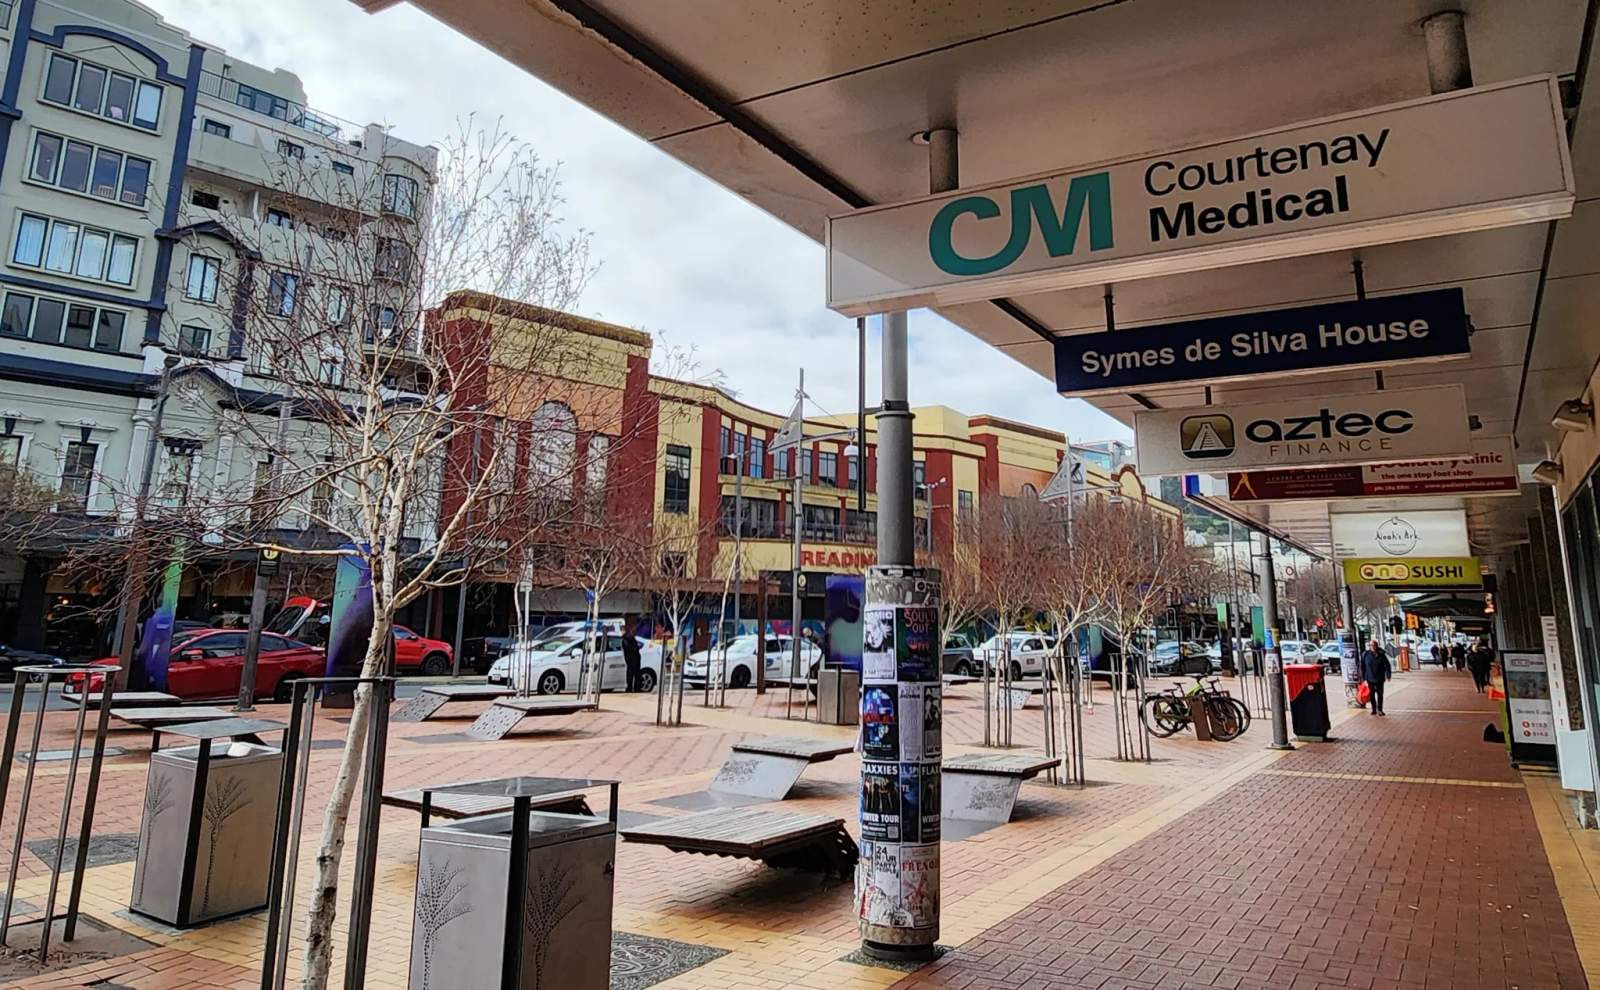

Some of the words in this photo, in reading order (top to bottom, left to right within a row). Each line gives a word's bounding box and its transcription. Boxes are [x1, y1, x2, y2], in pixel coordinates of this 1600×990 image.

[1144, 128, 1391, 197] Courtenay
[1148, 175, 1350, 242] Medical
[928, 171, 1114, 276] CM
[1081, 347, 1176, 377] Symes
[1185, 338, 1222, 362] de
[1231, 331, 1308, 359] Silva
[1318, 317, 1431, 348] House
[1245, 408, 1415, 444] aztec
[1269, 437, 1394, 457] FINANCE
[1451, 469, 1473, 477] shop
[1404, 529, 1421, 540] Ark
[801, 550, 877, 569] READIN
[1412, 565, 1464, 578] SUSHI
[880, 814, 899, 823] TOUR
[876, 846, 888, 854] 24
